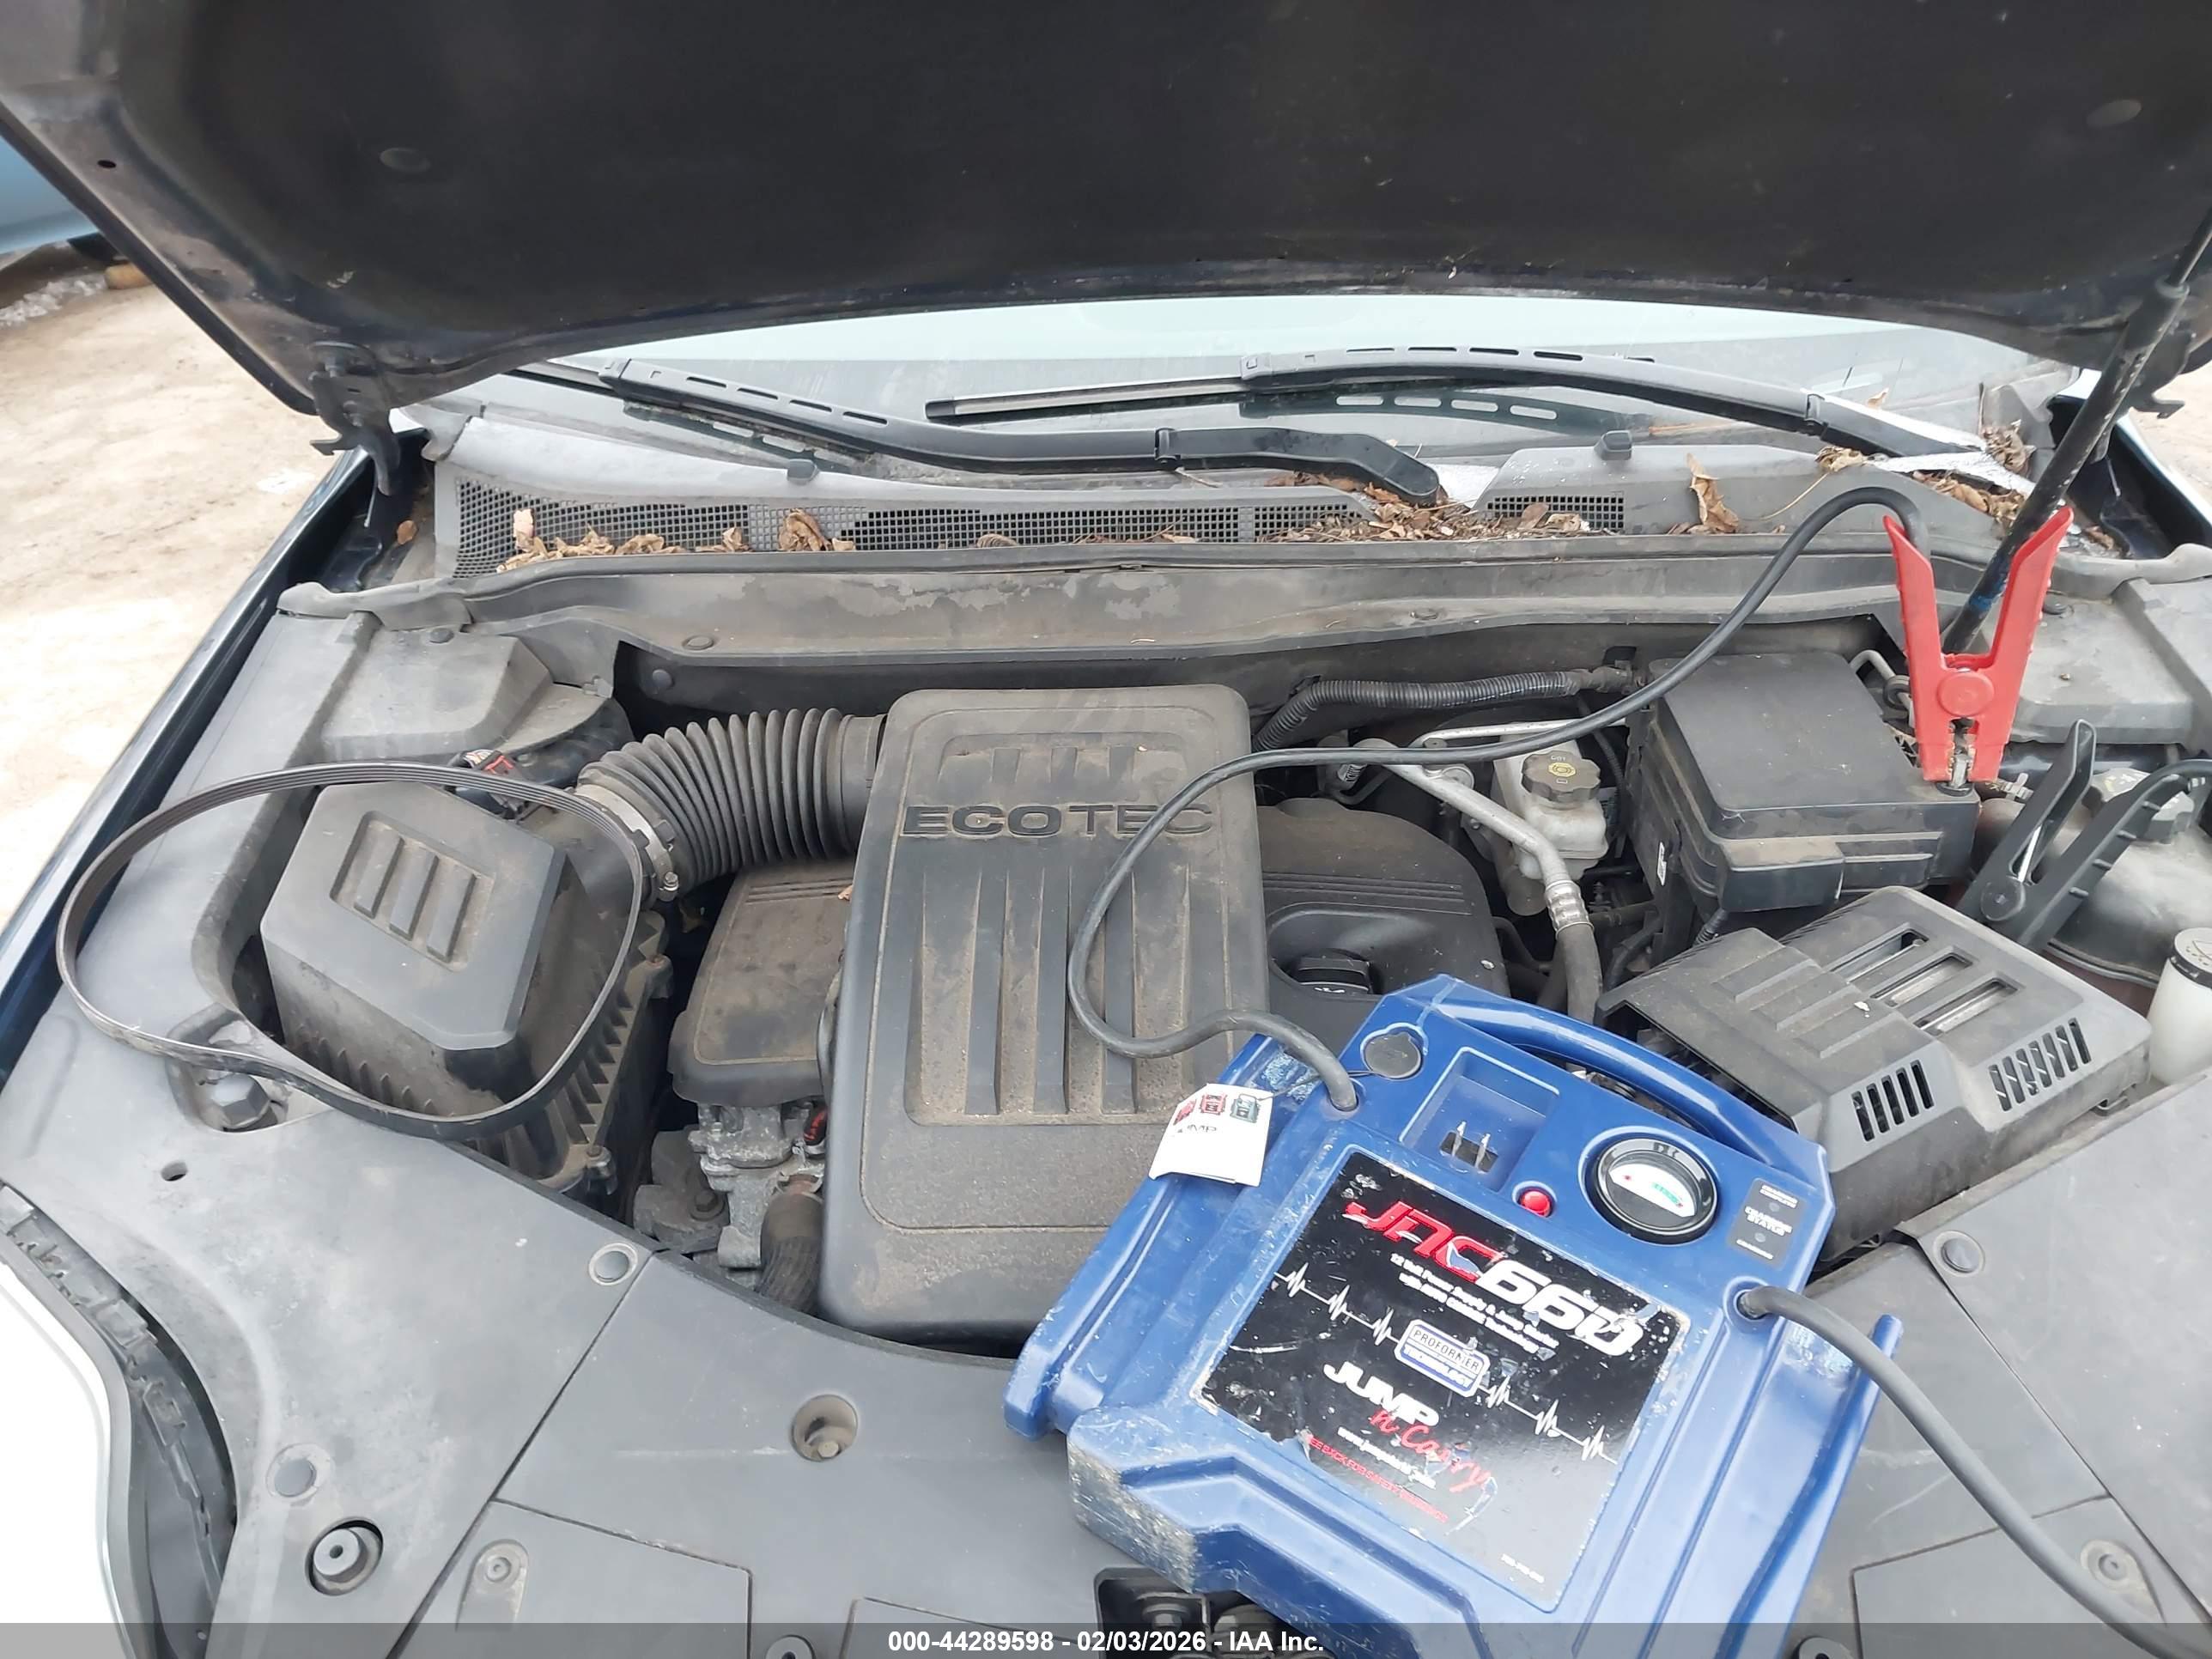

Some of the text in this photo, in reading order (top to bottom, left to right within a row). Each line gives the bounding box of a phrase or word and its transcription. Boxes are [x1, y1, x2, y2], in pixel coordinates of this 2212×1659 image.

[901, 804, 1212, 839] ECOTEC
[1747, 1214, 1785, 1236] STATUS
[1390, 1253, 1405, 1267] 12
[1323, 1361, 1439, 1426] JUMP
[1322, 1443, 1347, 1466] BACK
[1346, 1457, 1366, 1475] FOR
[1400, 1423, 1494, 1493] Carry
